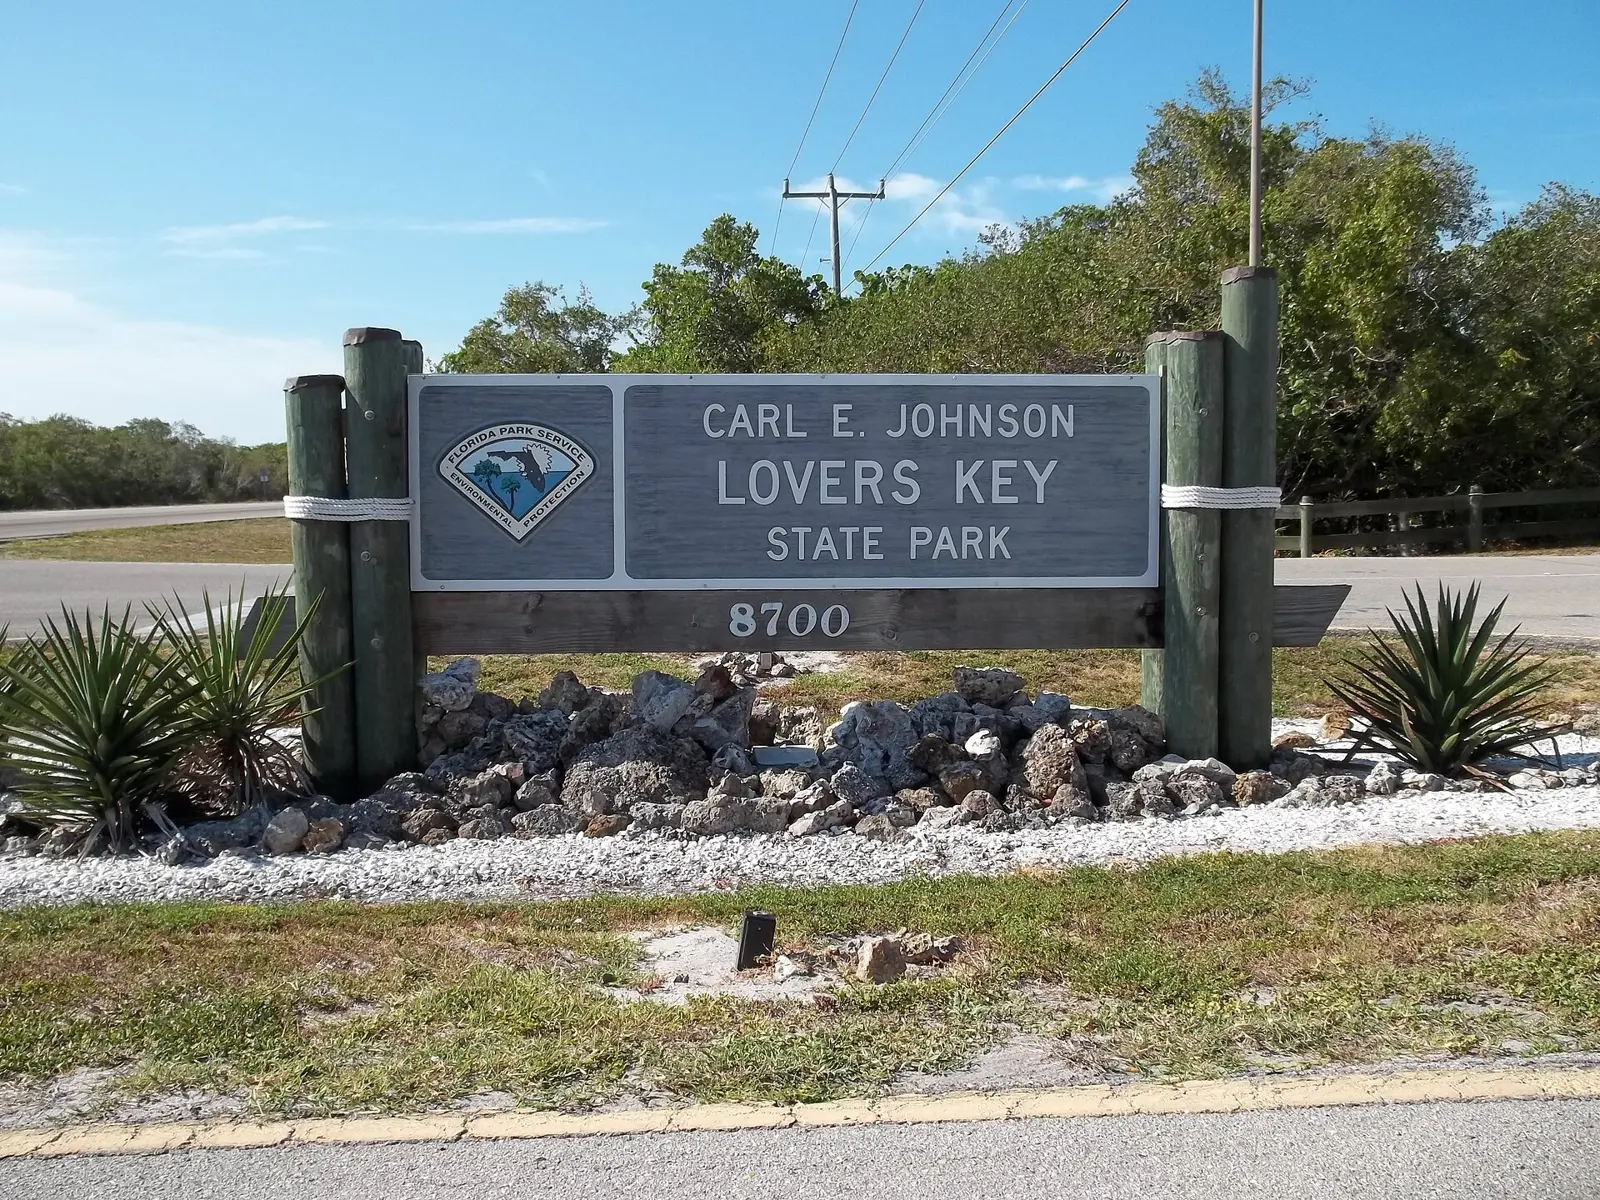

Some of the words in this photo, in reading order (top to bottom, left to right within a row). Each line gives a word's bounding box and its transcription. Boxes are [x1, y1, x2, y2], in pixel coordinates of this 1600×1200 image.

[702, 403, 807, 438] CARL
[832, 403, 865, 438] E.
[886, 403, 1075, 438] JOHNSON
[448, 430, 497, 464] FLORIDA
[499, 426, 534, 436] PARK
[537, 429, 586, 463] SERVICE
[450, 472, 512, 528] ENVIRONMENTAL
[523, 470, 586, 528] PROTECTION
[717, 459, 922, 505] LOVERS
[954, 459, 1059, 504] KEY
[766, 526, 884, 561] STATE
[909, 525, 1012, 560] PARK
[728, 601, 851, 638] 8700
